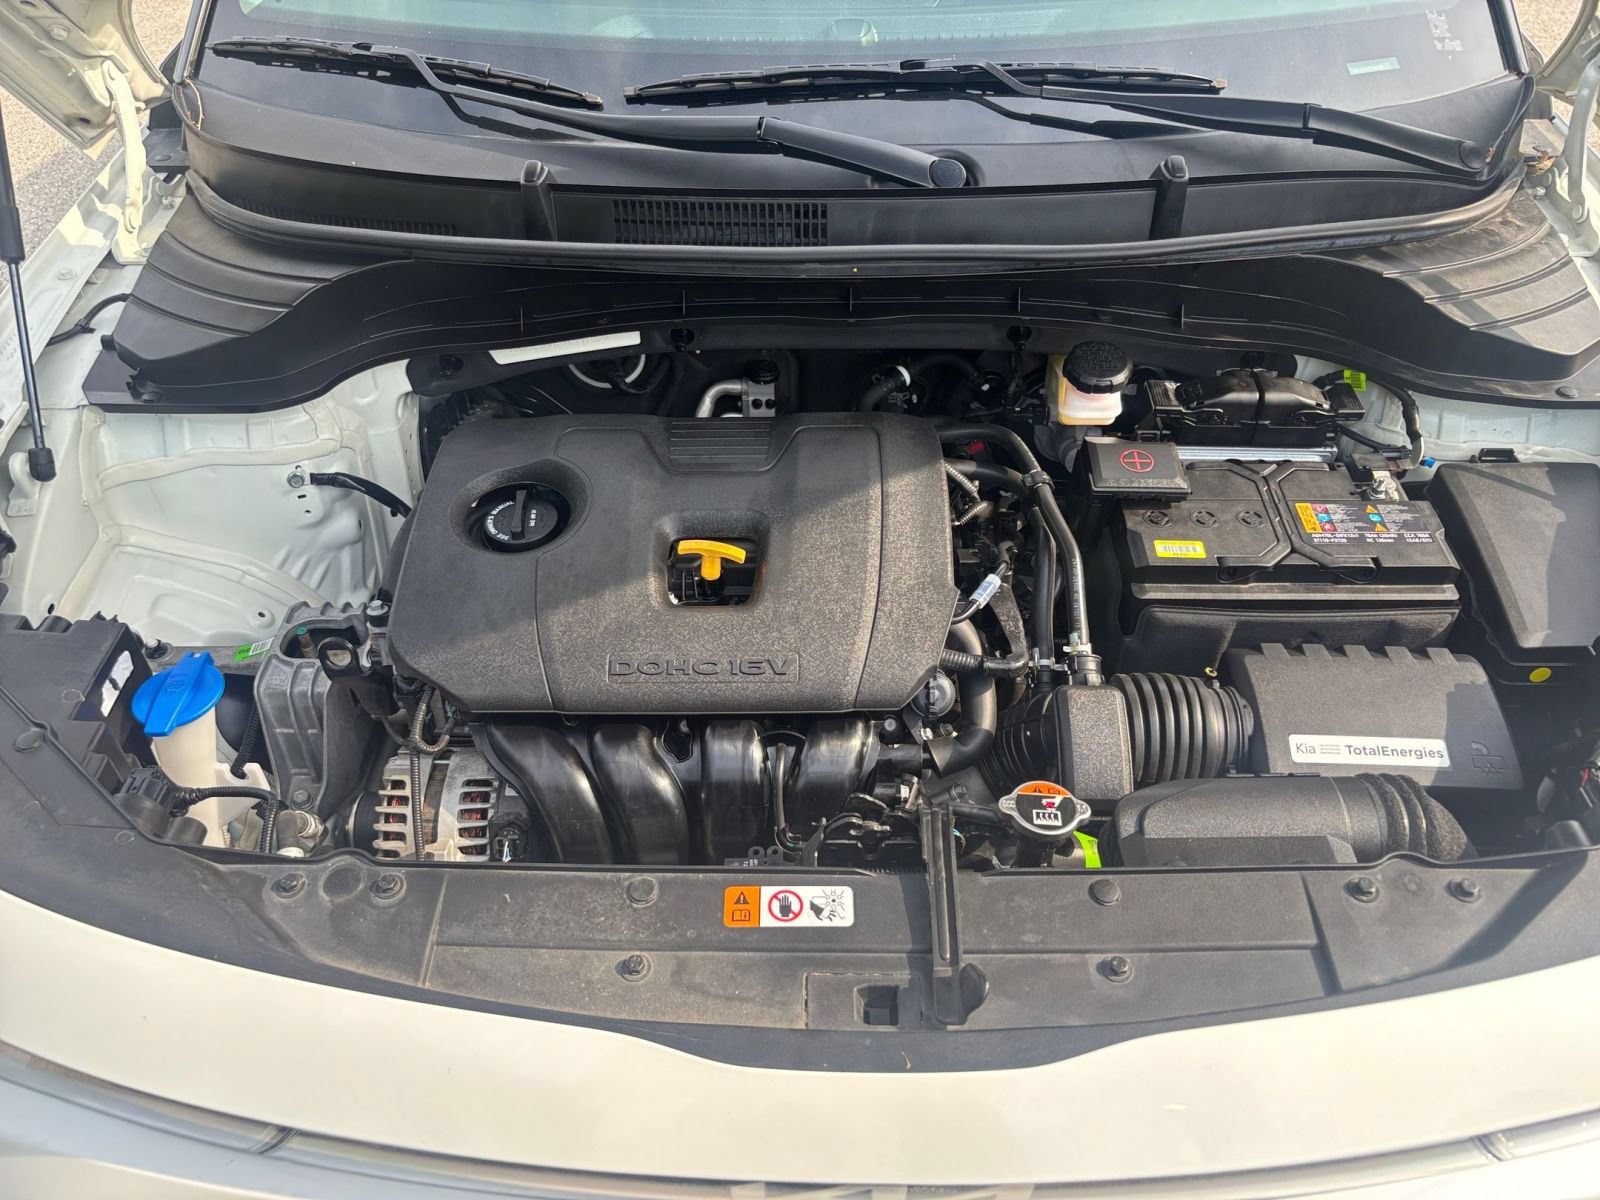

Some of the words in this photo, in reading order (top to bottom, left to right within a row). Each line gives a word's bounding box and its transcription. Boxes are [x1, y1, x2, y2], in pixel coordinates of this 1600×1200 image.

[609, 658, 720, 676] DOHC
[728, 658, 788, 676] 16V
[1295, 742, 1316, 754] Kia
[1344, 744, 1444, 760] TotalEnergies
